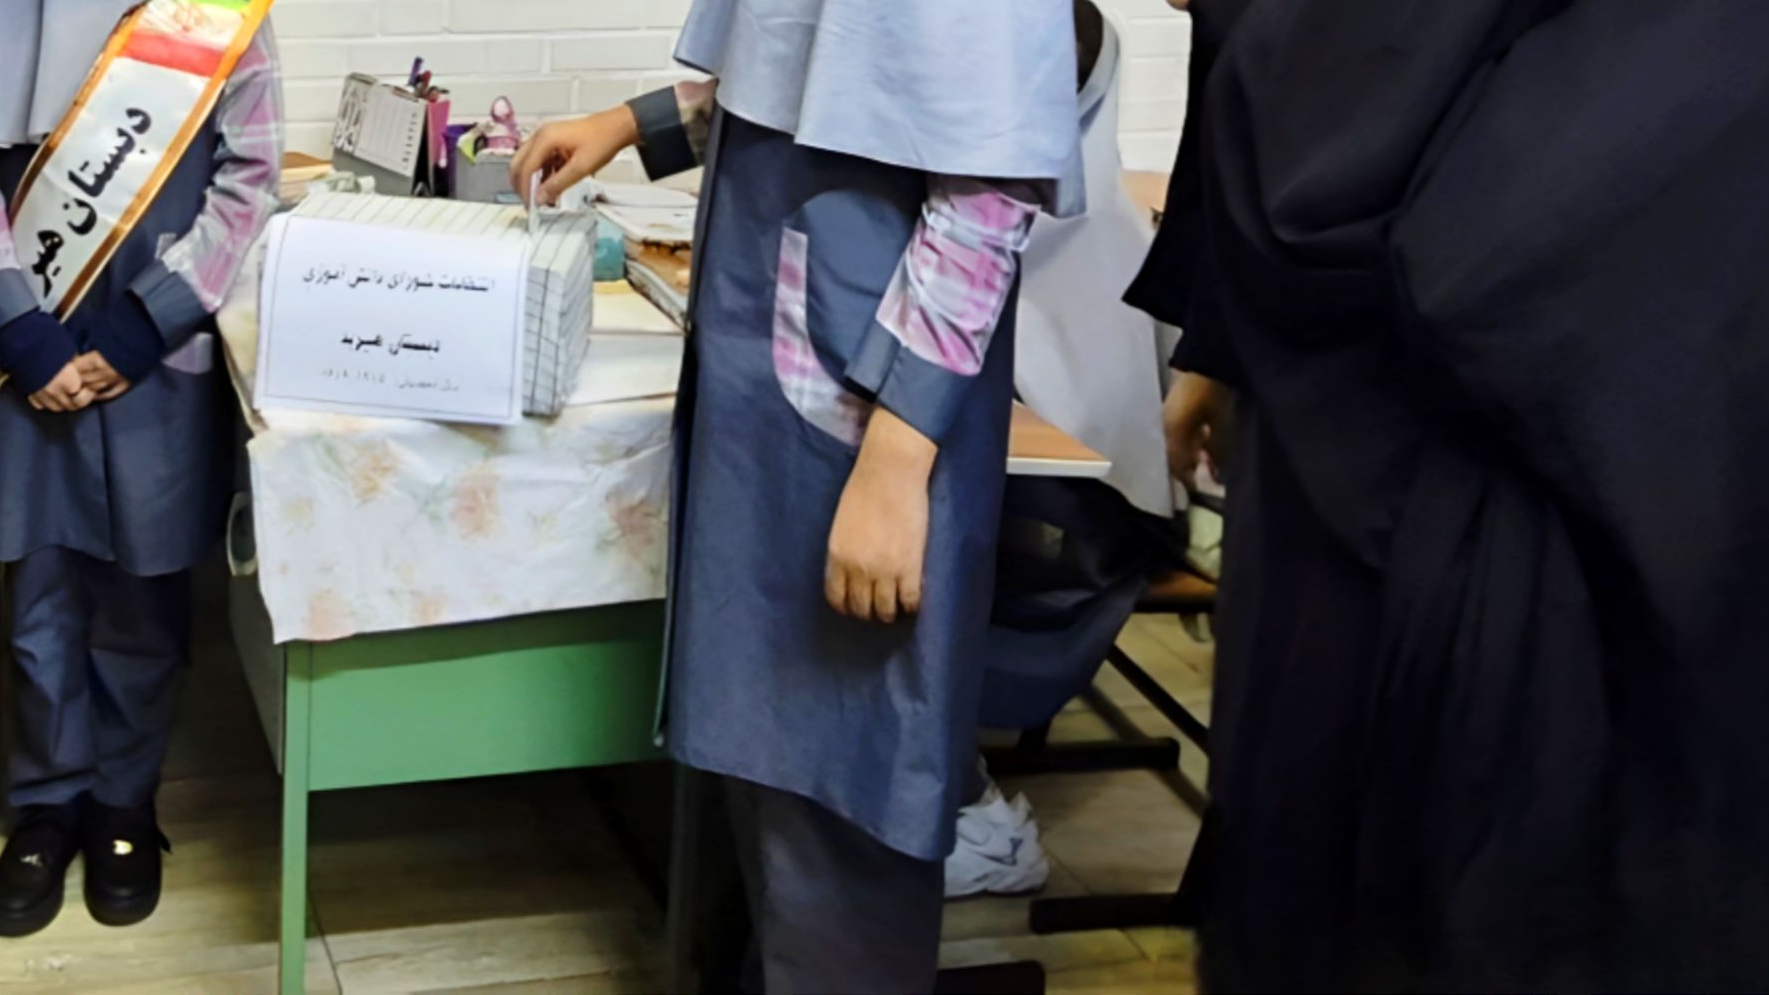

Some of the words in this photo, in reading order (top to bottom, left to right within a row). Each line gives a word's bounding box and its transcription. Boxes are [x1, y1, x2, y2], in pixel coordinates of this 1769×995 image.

[62, 107, 152, 236] دبستان
[31, 229, 65, 299] هیر
[348, 267, 384, 289] دانش
[386, 271, 434, 292] شورای
[388, 333, 440, 359] دبستان
